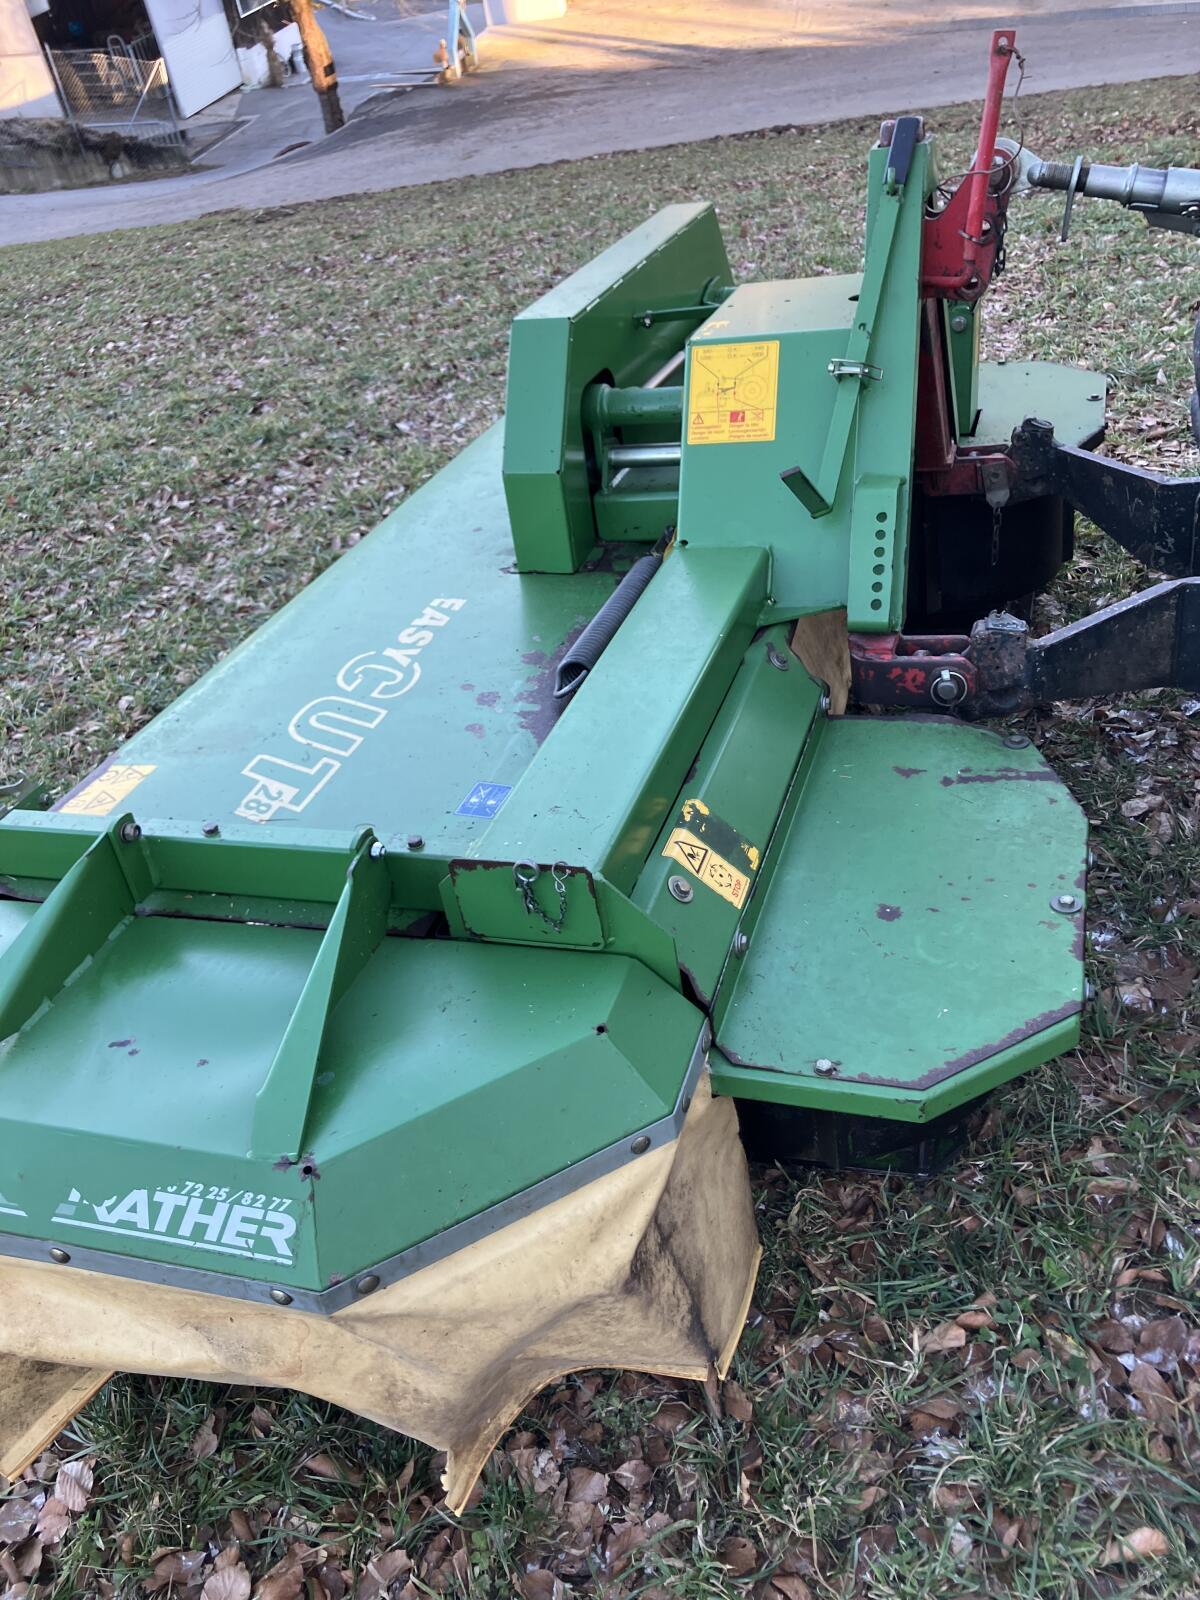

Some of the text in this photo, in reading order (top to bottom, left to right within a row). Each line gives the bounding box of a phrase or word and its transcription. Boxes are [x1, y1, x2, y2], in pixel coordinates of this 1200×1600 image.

[243, 783, 284, 815] 28
[732, 879, 741, 897] STOP
[181, 1181, 205, 1197] 72
[268, 1197, 293, 1212] 77
